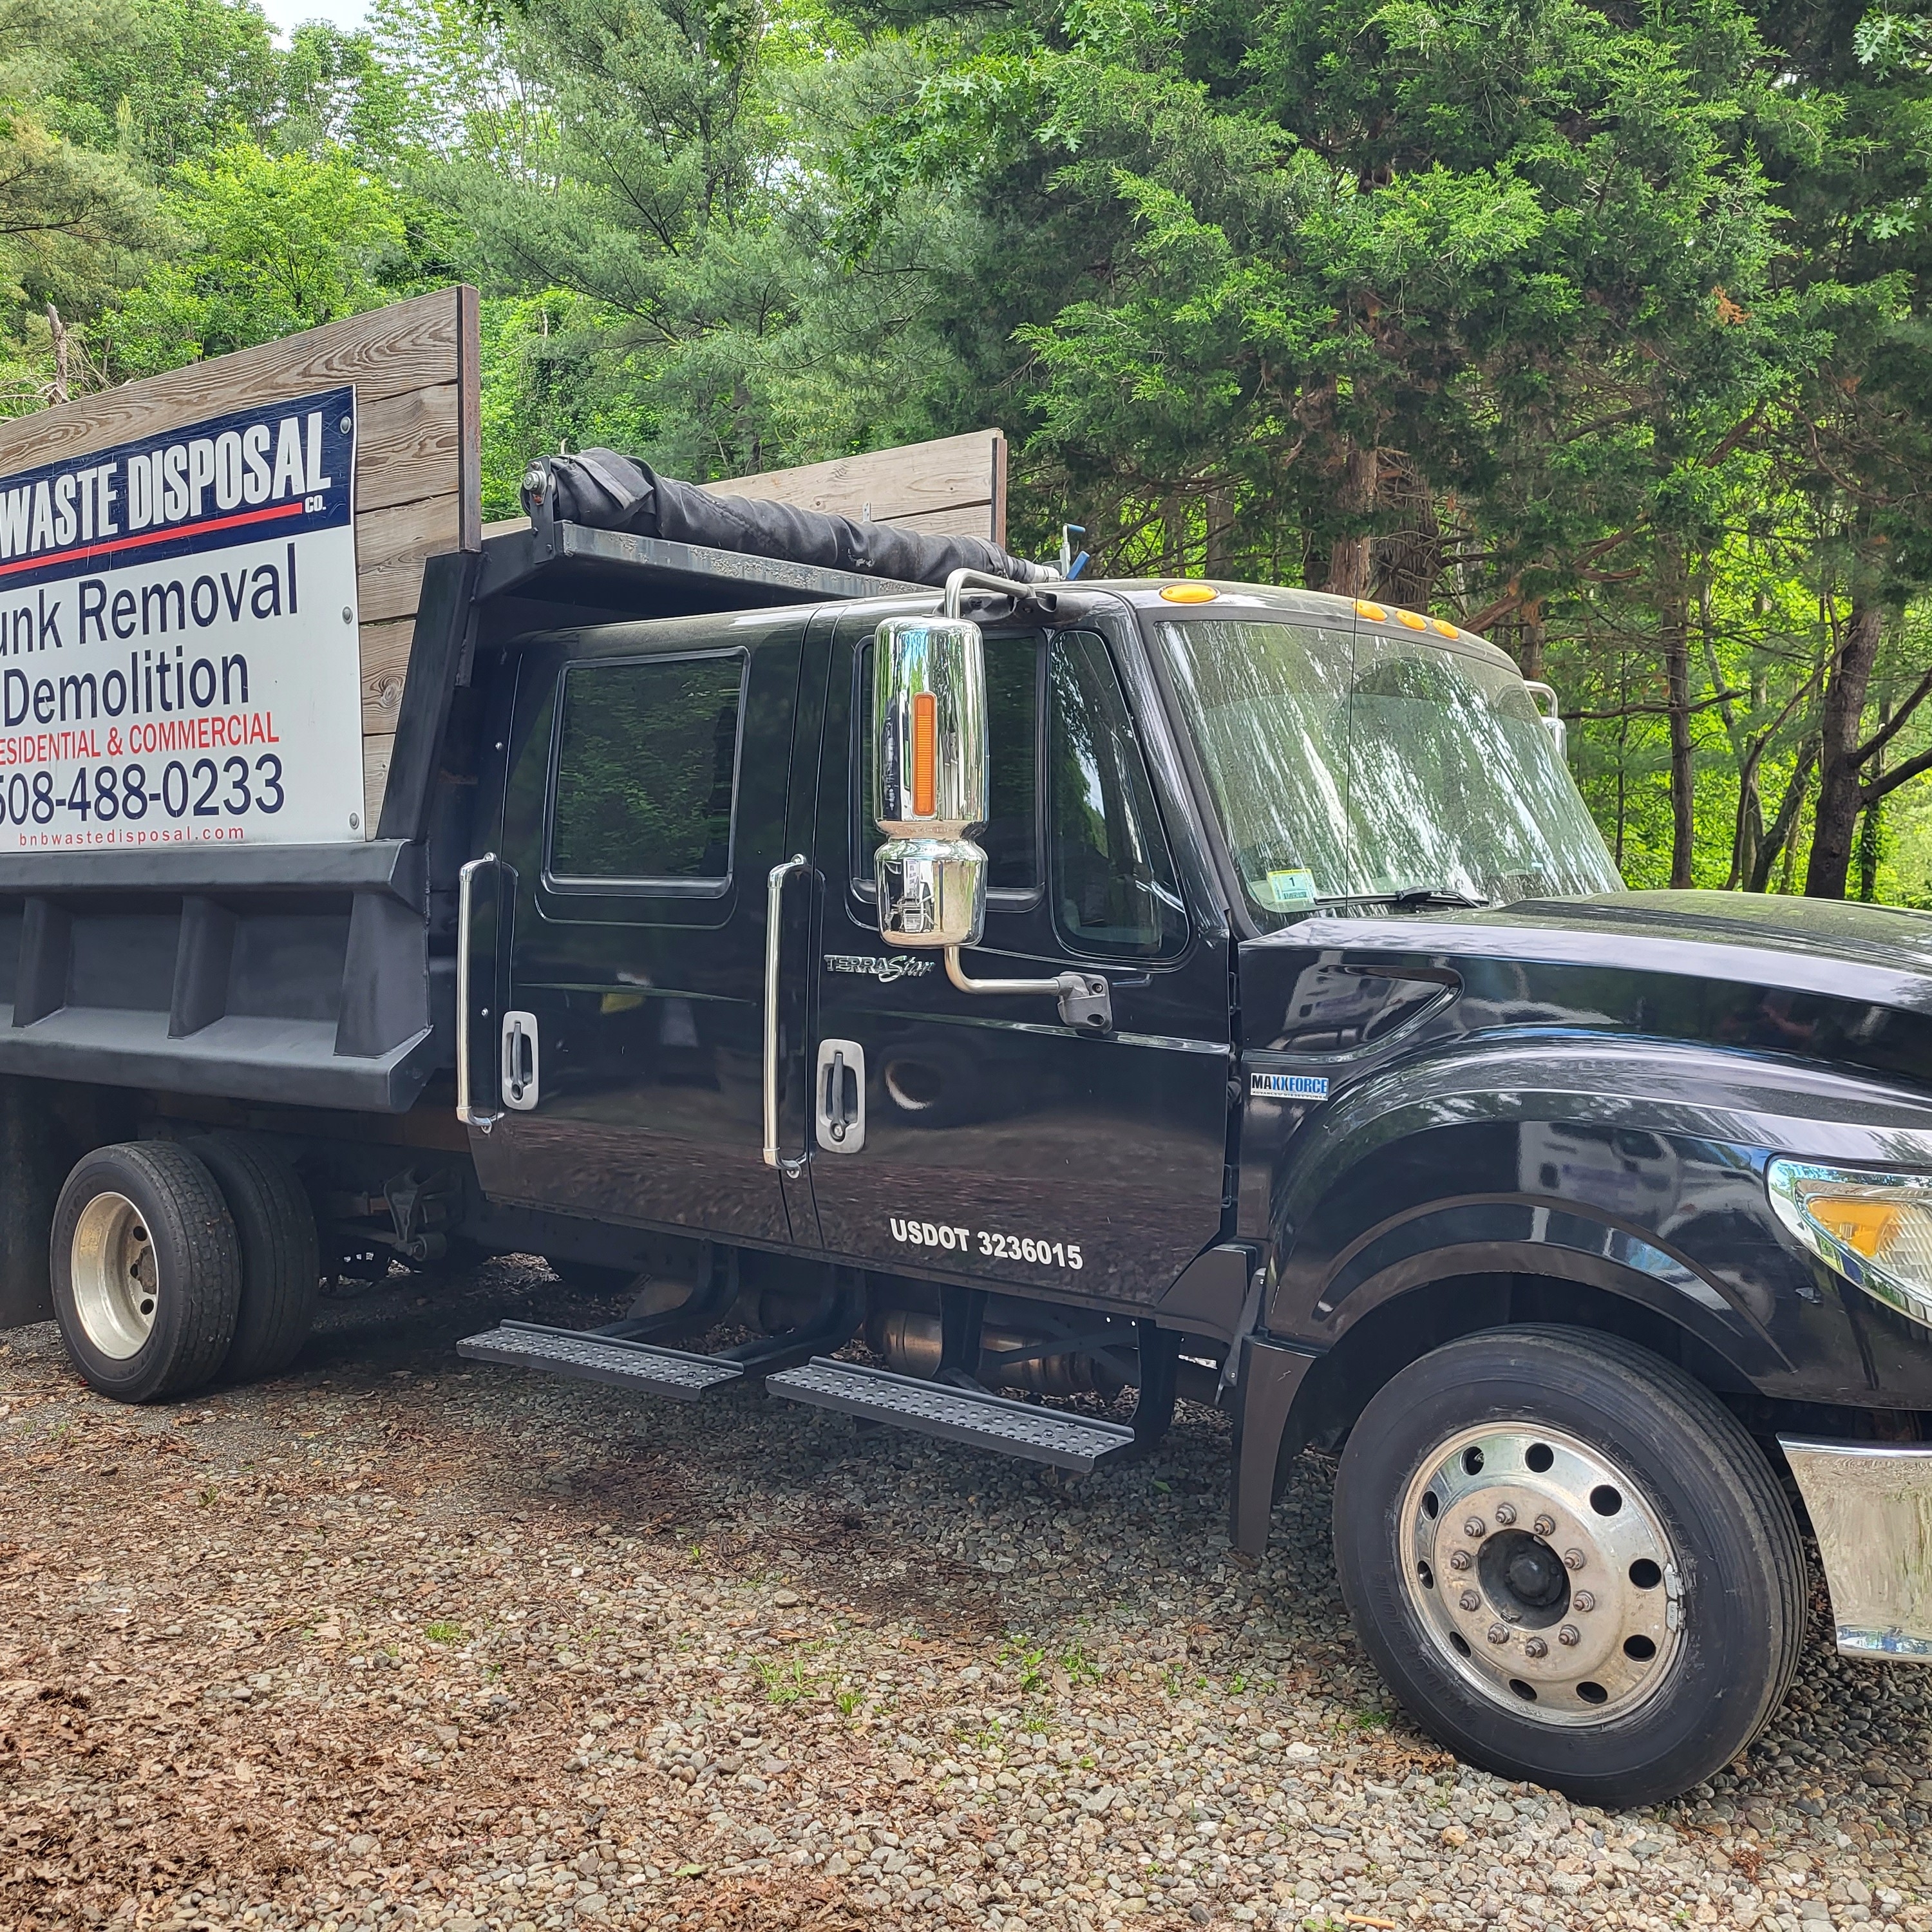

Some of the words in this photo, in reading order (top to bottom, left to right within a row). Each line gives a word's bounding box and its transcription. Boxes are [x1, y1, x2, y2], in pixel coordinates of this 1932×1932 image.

[0, 462, 118, 558] WASTE
[129, 412, 332, 530] DISPOSAL
[305, 495, 327, 513] CO.
[79, 542, 298, 643] Removal
[5, 646, 249, 727] Demolition
[107, 726, 123, 755] &
[130, 712, 279, 753] COMMERCIAL
[19, 826, 243, 846] bnbwastedisposal.com
[1252, 1074, 1328, 1094] MAXXFORCE
[890, 1218, 970, 1252] USDOT
[977, 1231, 1083, 1270] 3236015
